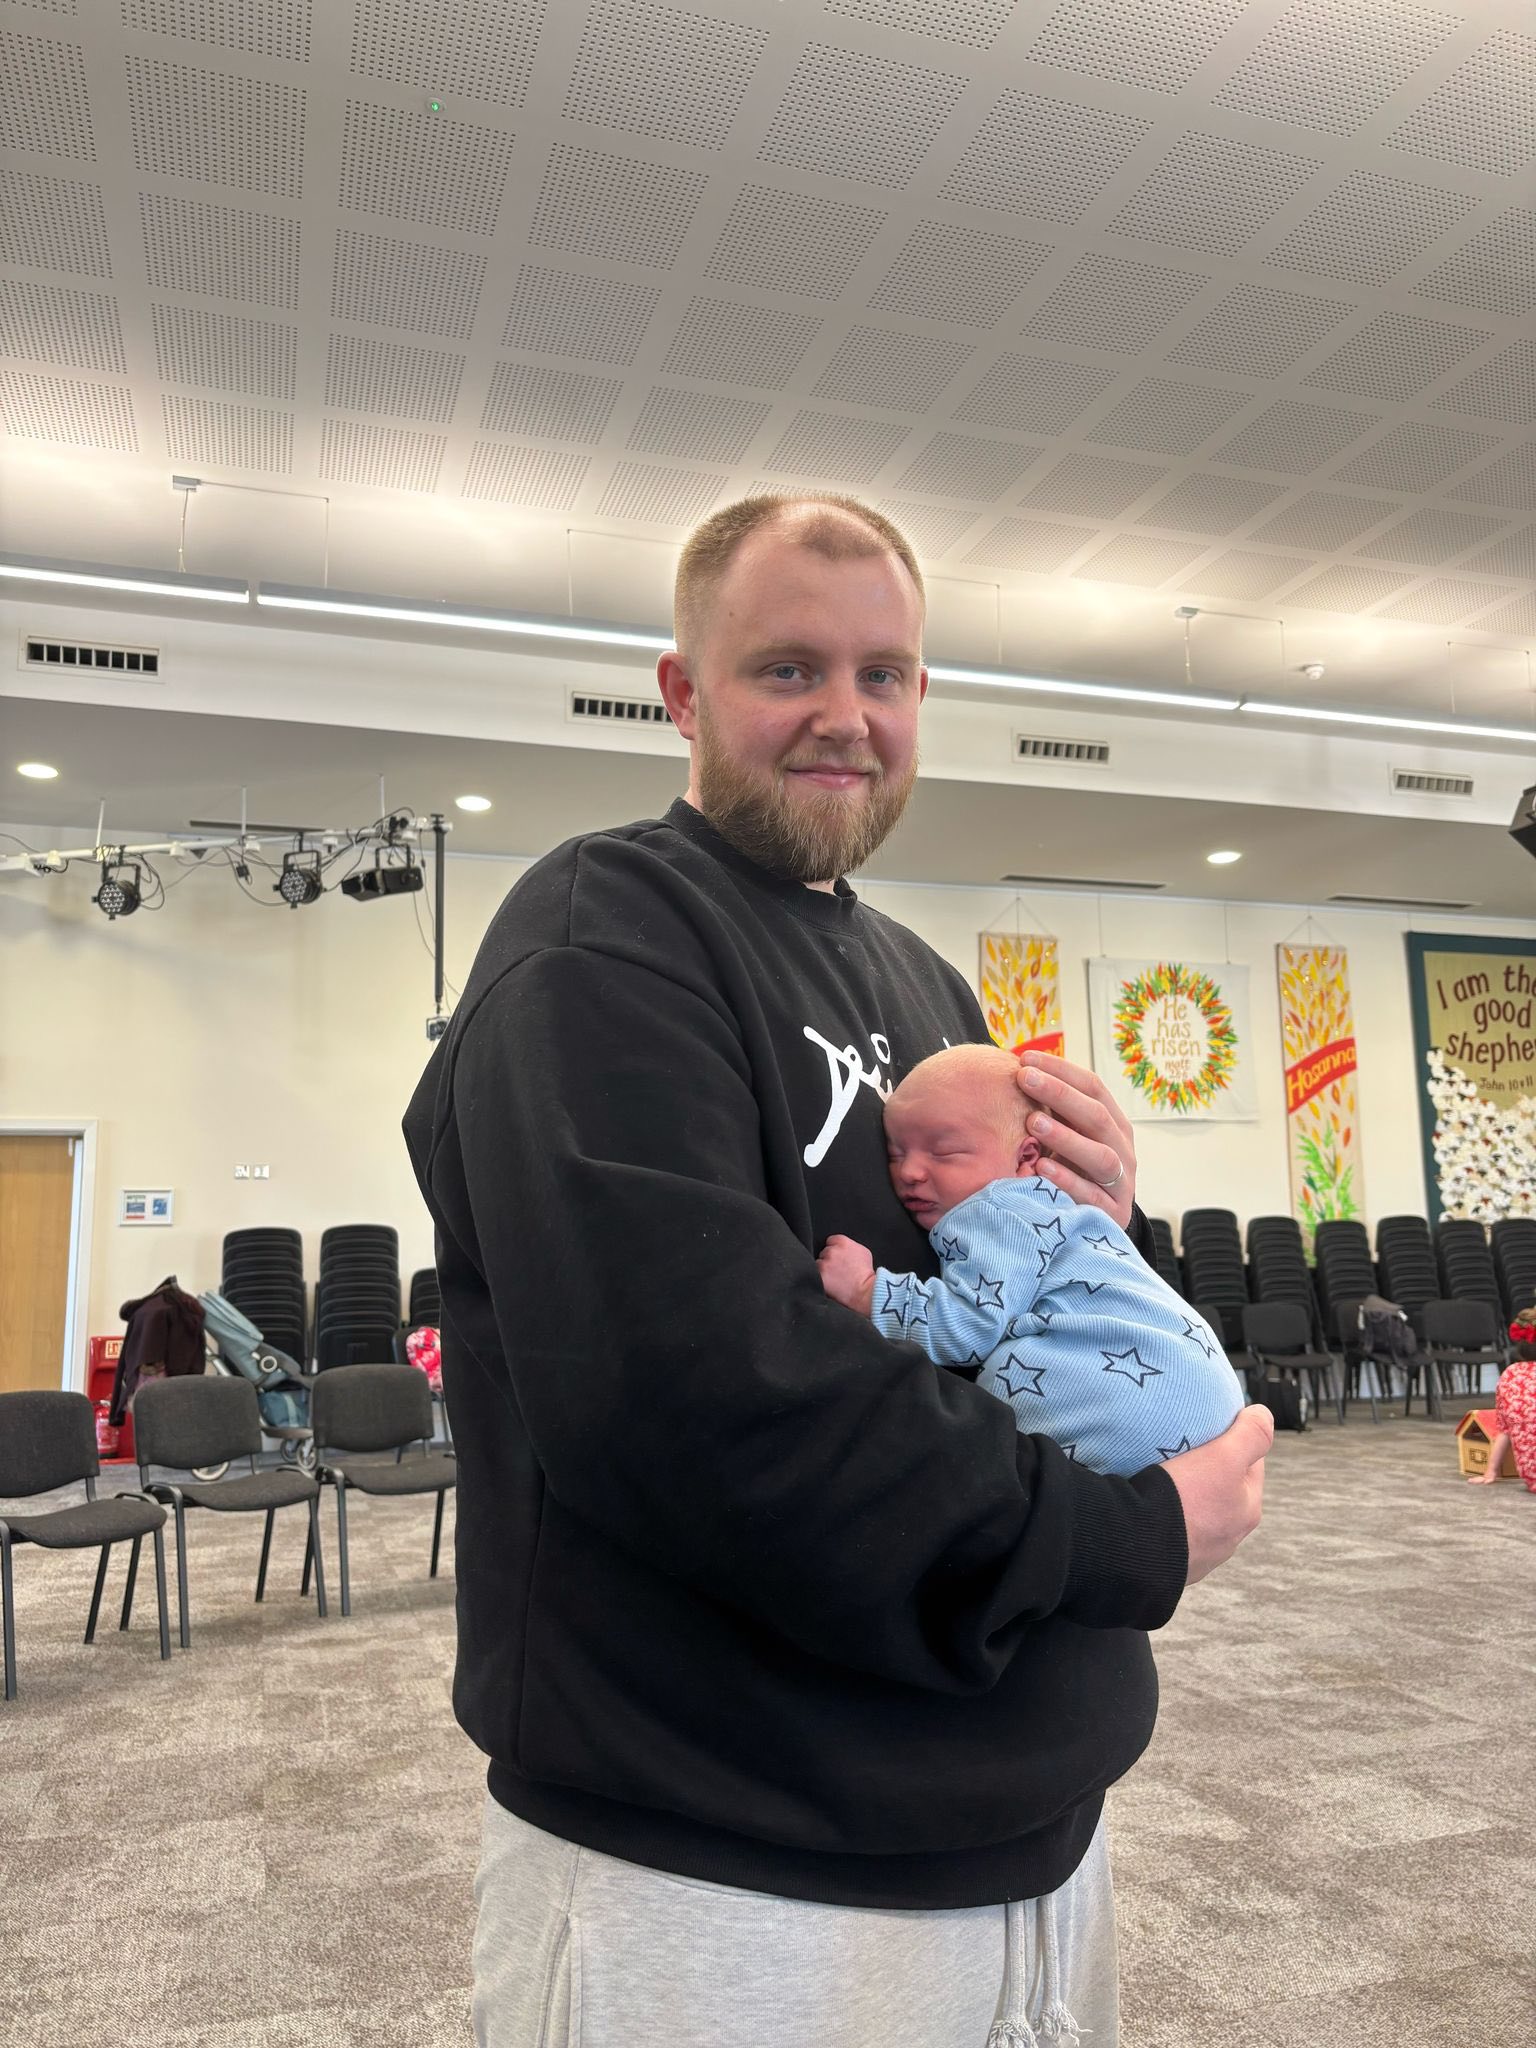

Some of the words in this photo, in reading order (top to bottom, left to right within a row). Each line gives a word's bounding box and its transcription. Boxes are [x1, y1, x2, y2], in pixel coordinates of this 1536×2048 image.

[1436, 979, 1448, 1010] I
[1453, 972, 1490, 1002] am
[1163, 998, 1187, 1021] He
[1474, 998, 1532, 1034] good
[1157, 1017, 1191, 1039] has
[1151, 1037, 1200, 1056] risen
[1446, 1031, 1536, 1073] shephe
[1287, 1046, 1355, 1109] Hosanna
[1479, 1077, 1505, 1091] John
